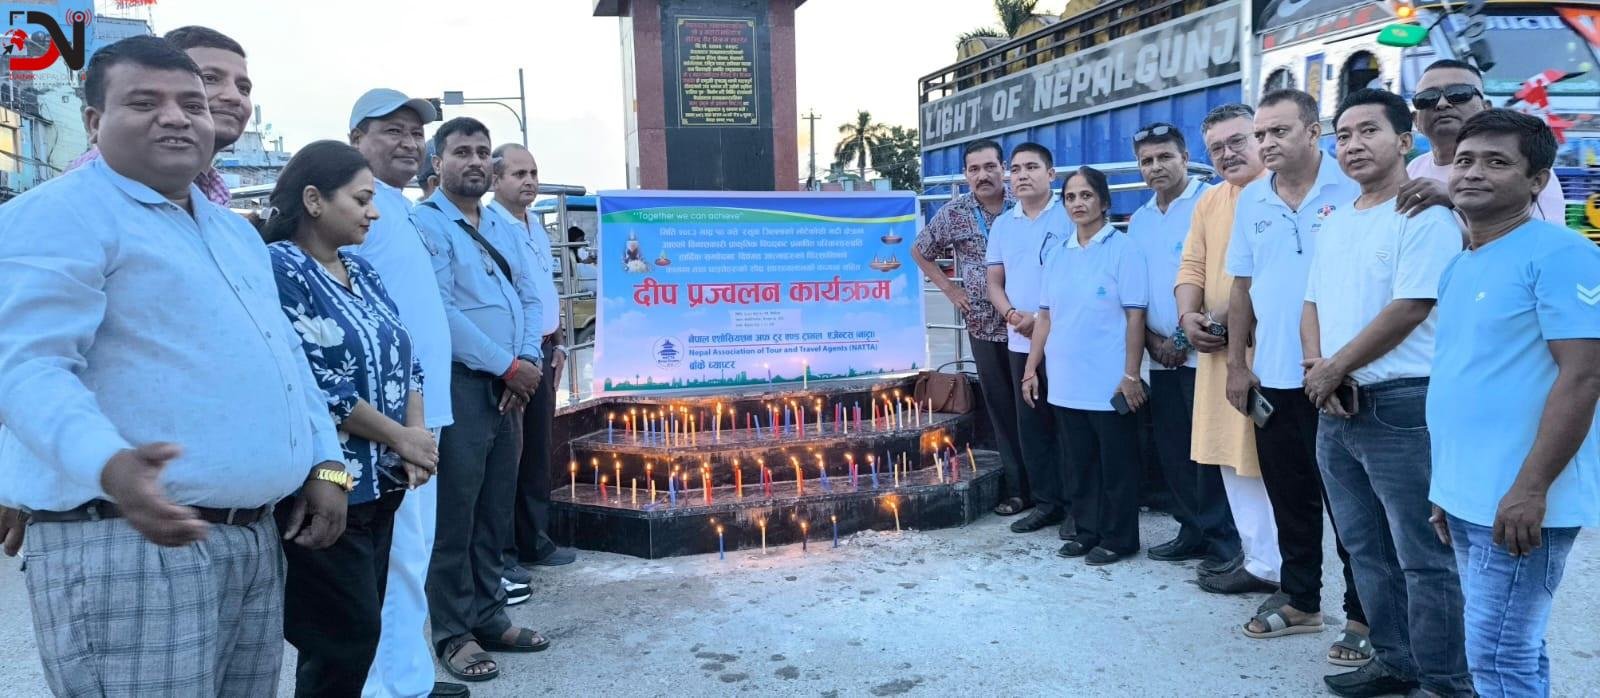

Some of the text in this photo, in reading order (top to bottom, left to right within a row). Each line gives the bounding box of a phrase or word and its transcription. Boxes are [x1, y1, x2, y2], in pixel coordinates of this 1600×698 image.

[924, 96, 981, 140] LIGHT
[991, 84, 1023, 122] OF
[1032, 17, 1237, 112] NEPALGUNJ
[633, 275, 892, 308] दीप प्रज्वलन कार्यक्रम
[688, 333, 710, 343] नेपाल
[688, 348, 711, 357] Nepal
[712, 347, 756, 356] Association
[766, 346, 782, 354] Tour
[784, 345, 798, 353] and
[799, 345, 821, 353] Travel
[823, 344, 848, 354] Agents
[849, 343, 878, 353] (NATTA)
